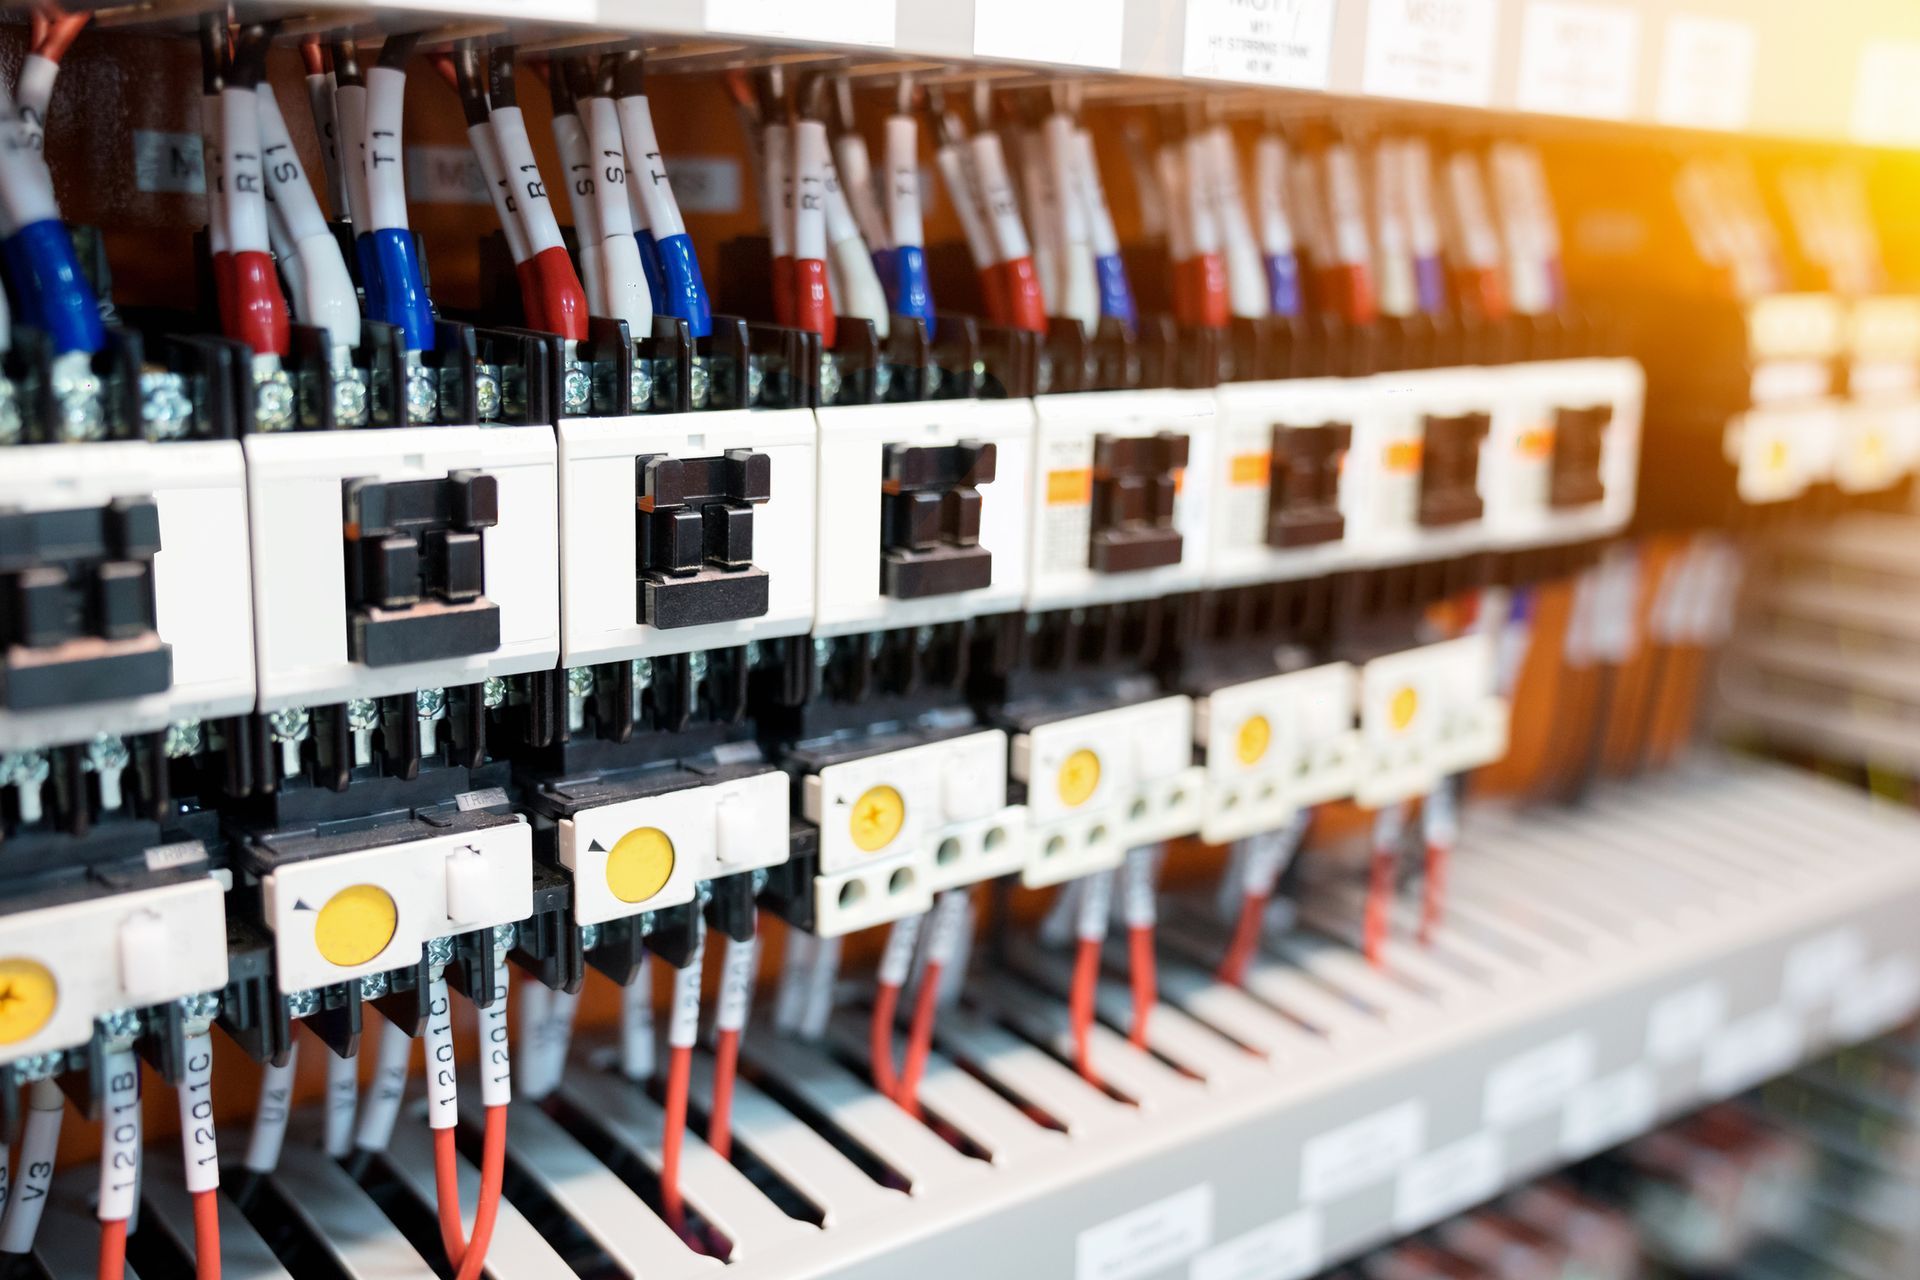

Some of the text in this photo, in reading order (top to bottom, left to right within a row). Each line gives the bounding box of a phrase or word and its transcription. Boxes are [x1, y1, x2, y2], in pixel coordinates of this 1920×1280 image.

[265, 144, 298, 183] S1
[372, 131, 395, 169] T1
[604, 150, 624, 184] S1
[646, 152, 667, 185] T1
[234, 153, 259, 193] R1
[520, 164, 546, 198] R1
[572, 164, 595, 196] S1
[430, 997, 456, 1106] 1201C
[189, 1053, 217, 1166] 1201C
[111, 1071, 137, 1191] 1201B
[21, 1161, 51, 1202] V3
